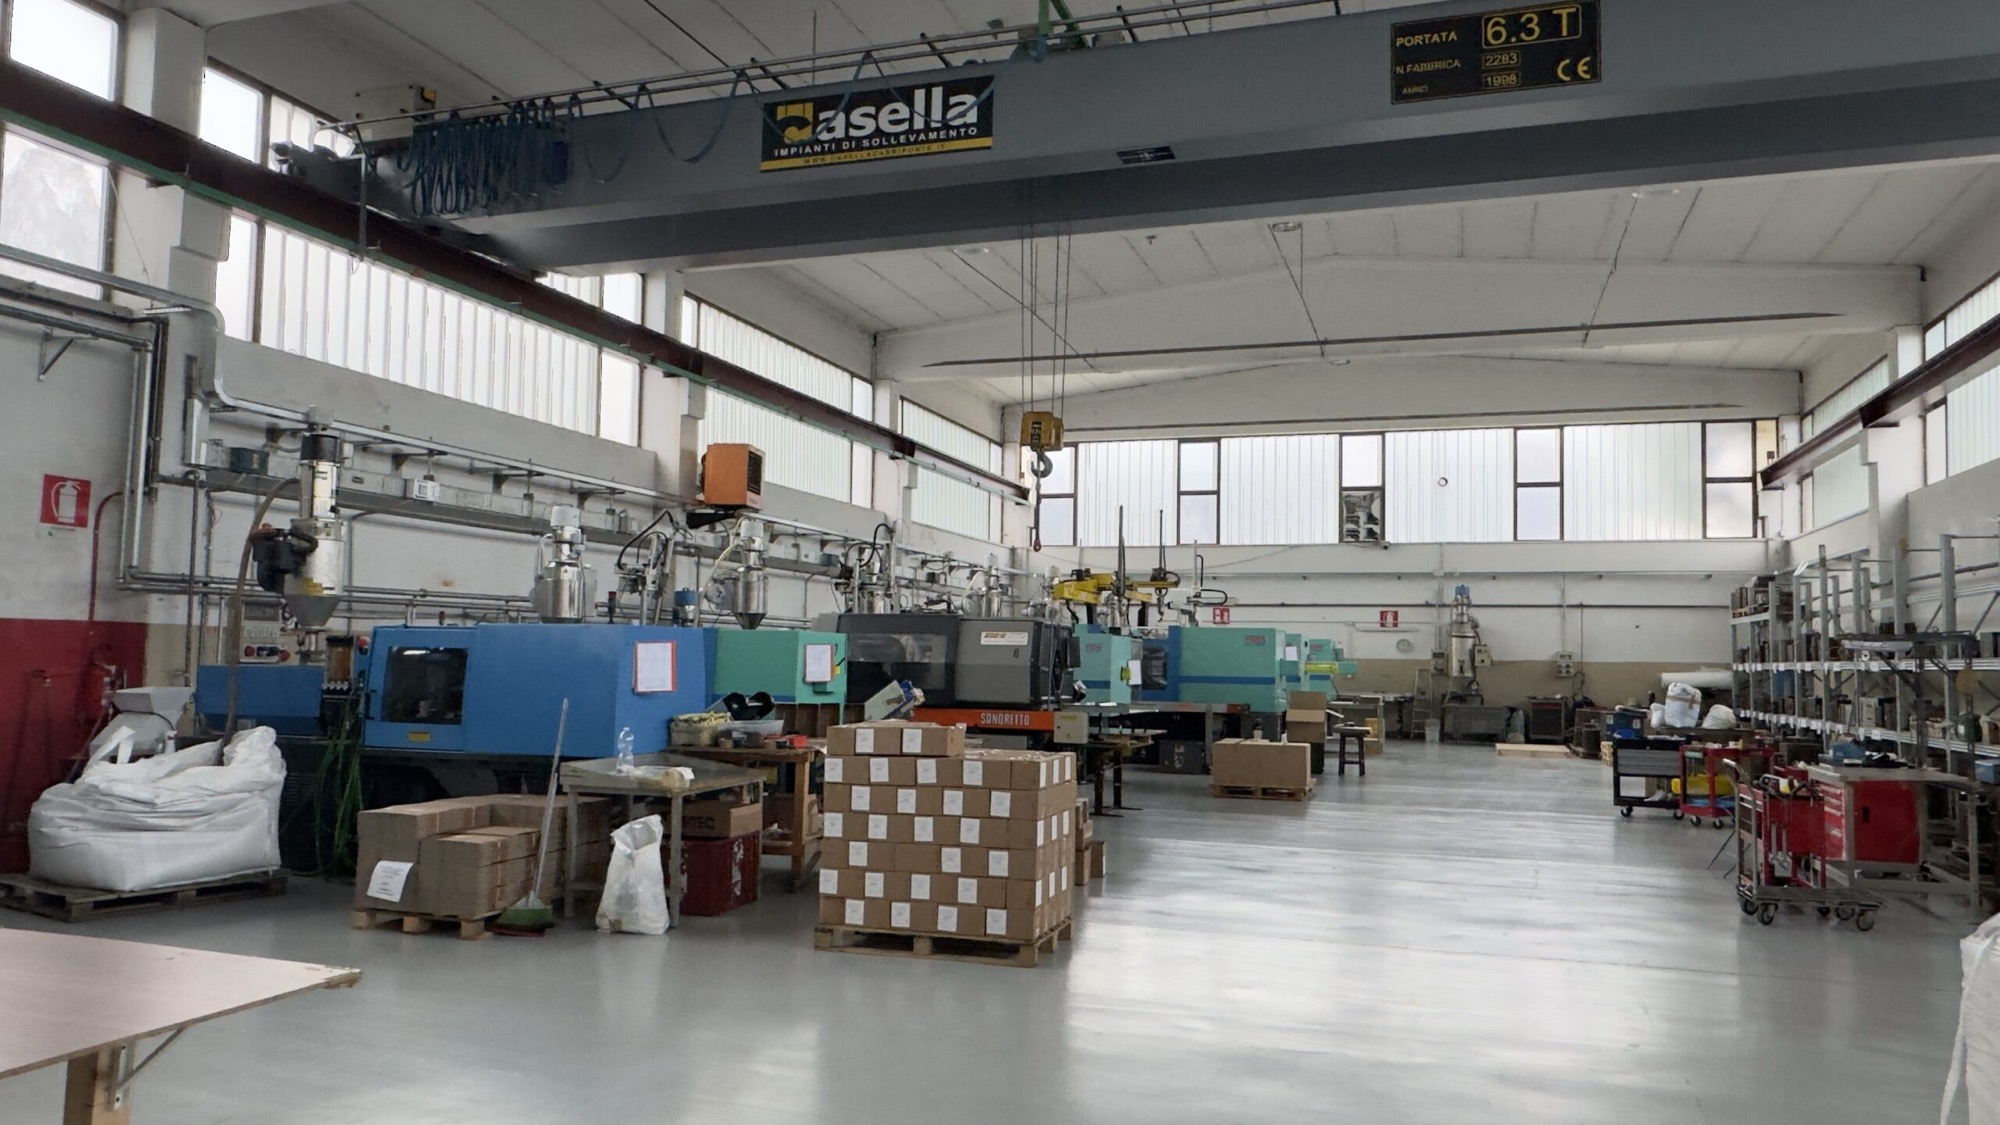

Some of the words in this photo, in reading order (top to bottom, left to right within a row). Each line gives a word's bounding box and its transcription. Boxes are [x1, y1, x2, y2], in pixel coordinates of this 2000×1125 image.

[1486, 13, 1541, 45] 6.3
[1552, 8, 1577, 37] T
[1396, 31, 1458, 47] PORTATA
[774, 143, 836, 158] IMPIANTI
[842, 141, 855, 150] DI
[862, 126, 978, 148] SOLLEVAMENTO
[980, 712, 1030, 727] SANDRETTO
